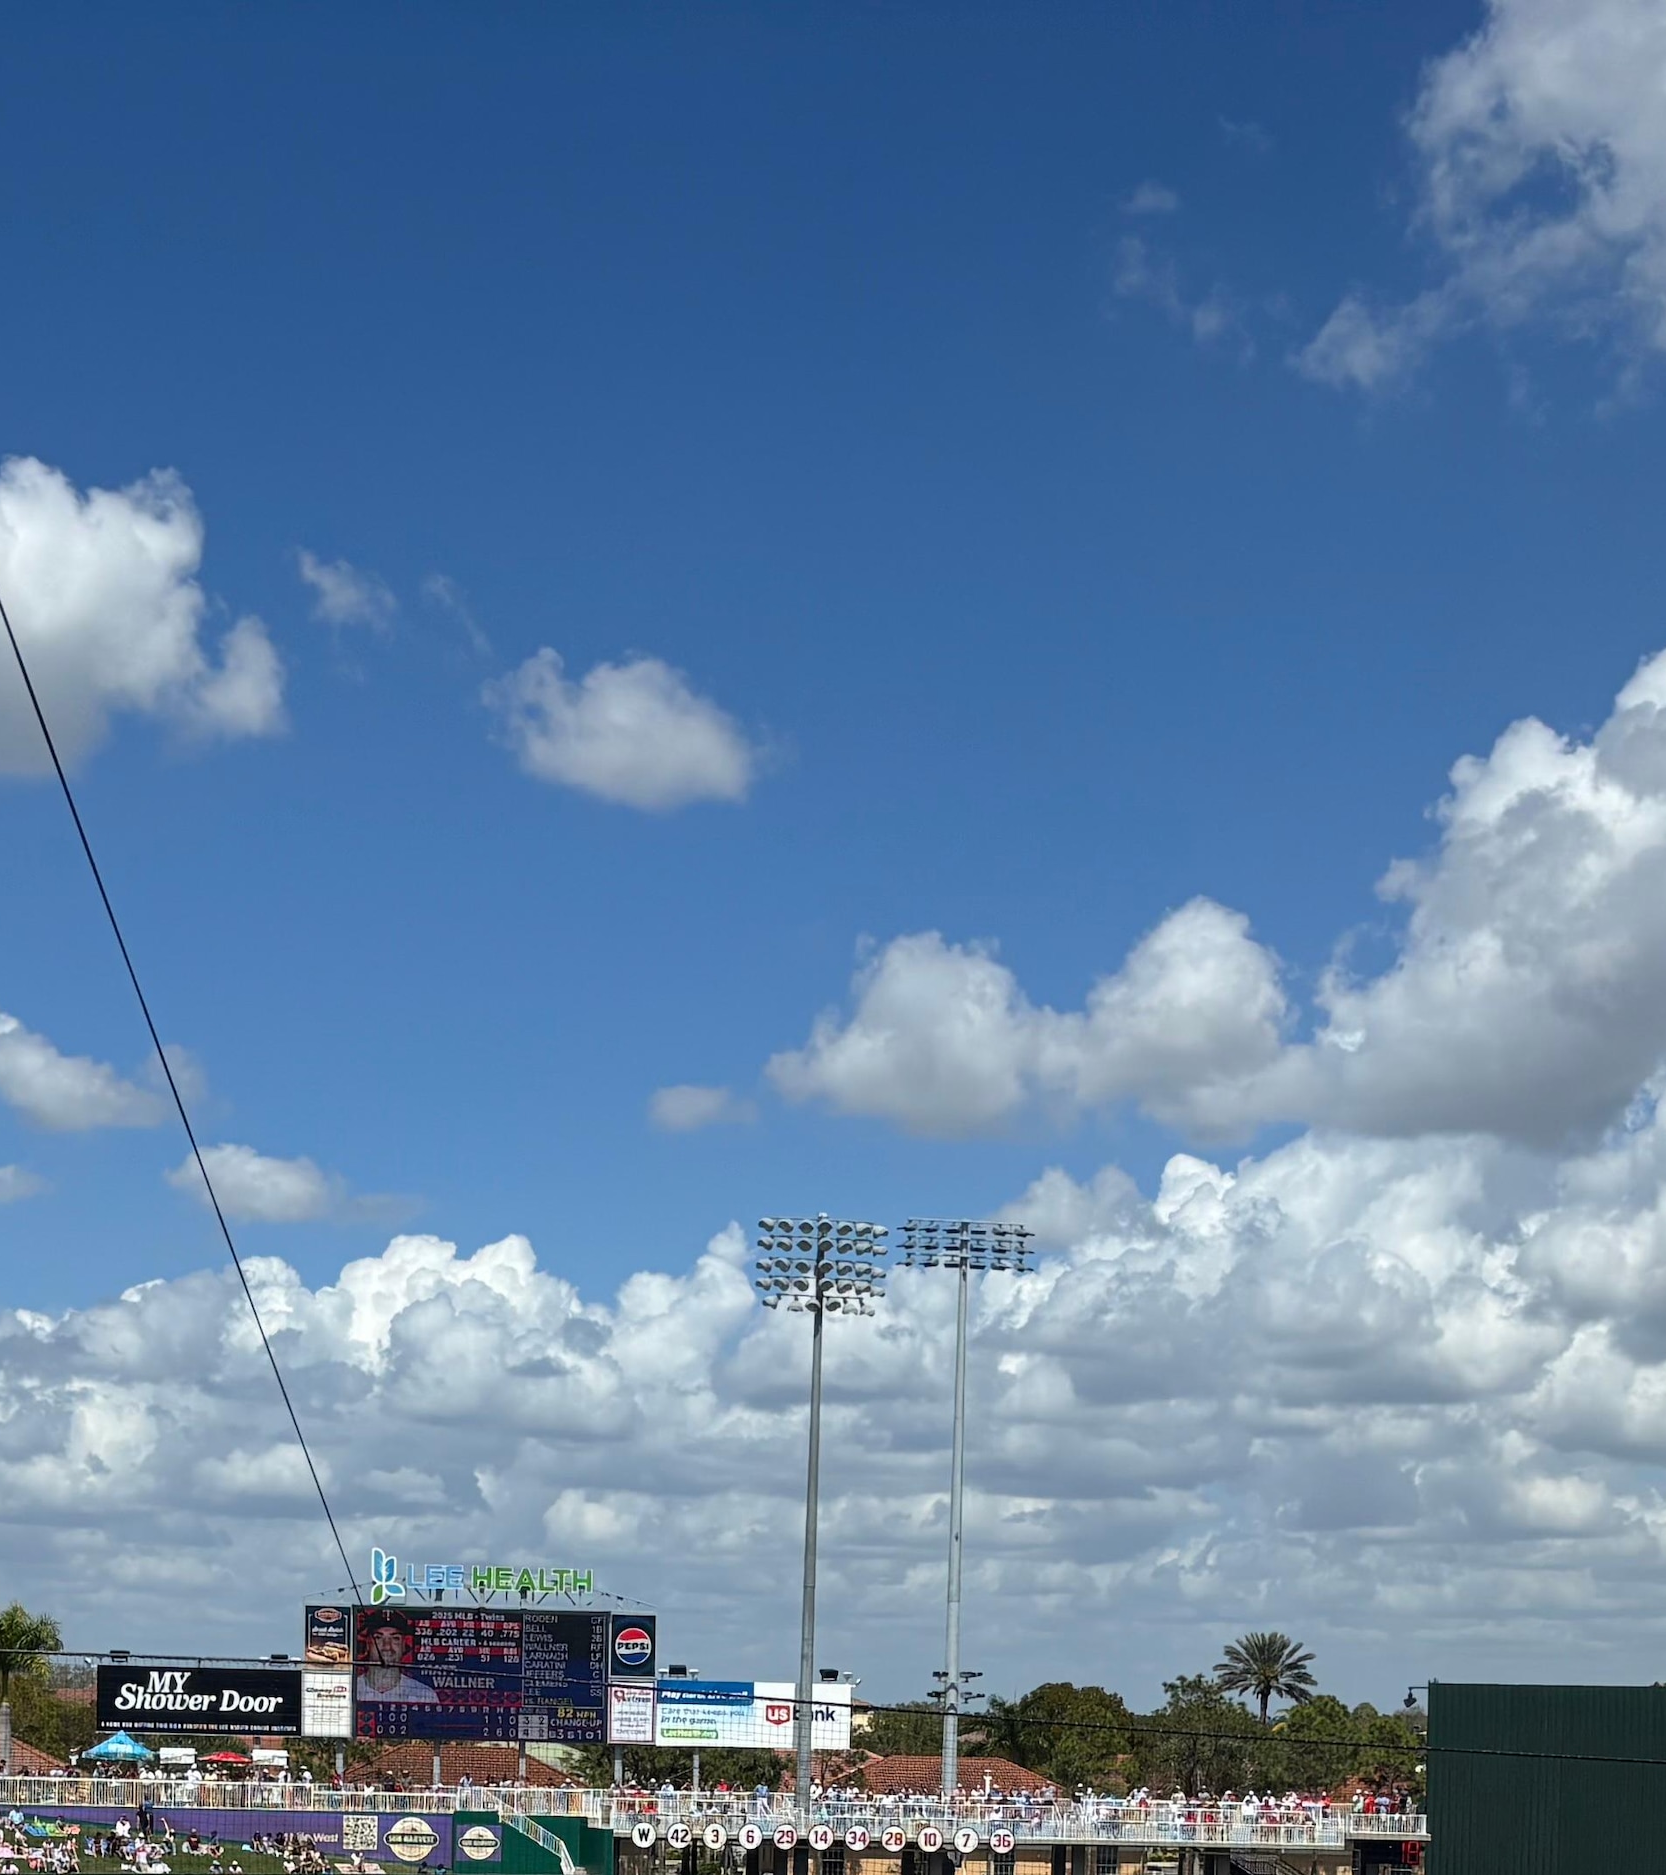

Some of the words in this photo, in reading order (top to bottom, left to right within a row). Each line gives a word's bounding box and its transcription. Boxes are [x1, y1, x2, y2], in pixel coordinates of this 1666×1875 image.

[407, 1564, 463, 1589] LEE
[471, 1565, 593, 1594] HEALTH
[525, 1614, 558, 1623] RODEN
[436, 1628, 457, 1636] .202
[462, 1629, 474, 1637] 22
[525, 1624, 546, 1632] BELL
[525, 1634, 553, 1642] LEWIS
[525, 1643, 568, 1651] WALLNER
[617, 1642, 649, 1651] PEPSI
[525, 1652, 568, 1660] LARNACH
[524, 1661, 566, 1669] CARATINI
[146, 1672, 191, 1693] MY
[433, 1677, 495, 1688] WALLNER
[525, 1688, 541, 1696] LEE
[115, 1684, 215, 1711] Shower
[219, 1690, 283, 1713] Door
[389, 1713, 395, 1721] 0
[400, 1713, 407, 1721] 0
[509, 1716, 516, 1724] 0
[557, 1708, 573, 1718] 82
[768, 1708, 788, 1720] us
[793, 1705, 835, 1722] bnk
[551, 1718, 602, 1727] CHANGE-UP
[377, 1726, 383, 1734] 0
[389, 1726, 395, 1734] 0
[401, 1726, 406, 1734] 2
[484, 1728, 489, 1736] 2
[509, 1729, 515, 1737] 0
[557, 1730, 563, 1739] 3
[639, 1828, 650, 1843] W
[671, 1829, 689, 1843] 42
[711, 1830, 719, 1843] 3
[745, 1830, 754, 1844] 6
[777, 1830, 795, 1845] 29
[814, 1830, 828, 1844] 14
[848, 1830, 867, 1845] 34
[885, 1831, 903, 1846] 28
[923, 1832, 937, 1846] 10
[961, 1833, 971, 1848] 7
[993, 1834, 1011, 1848] 36
